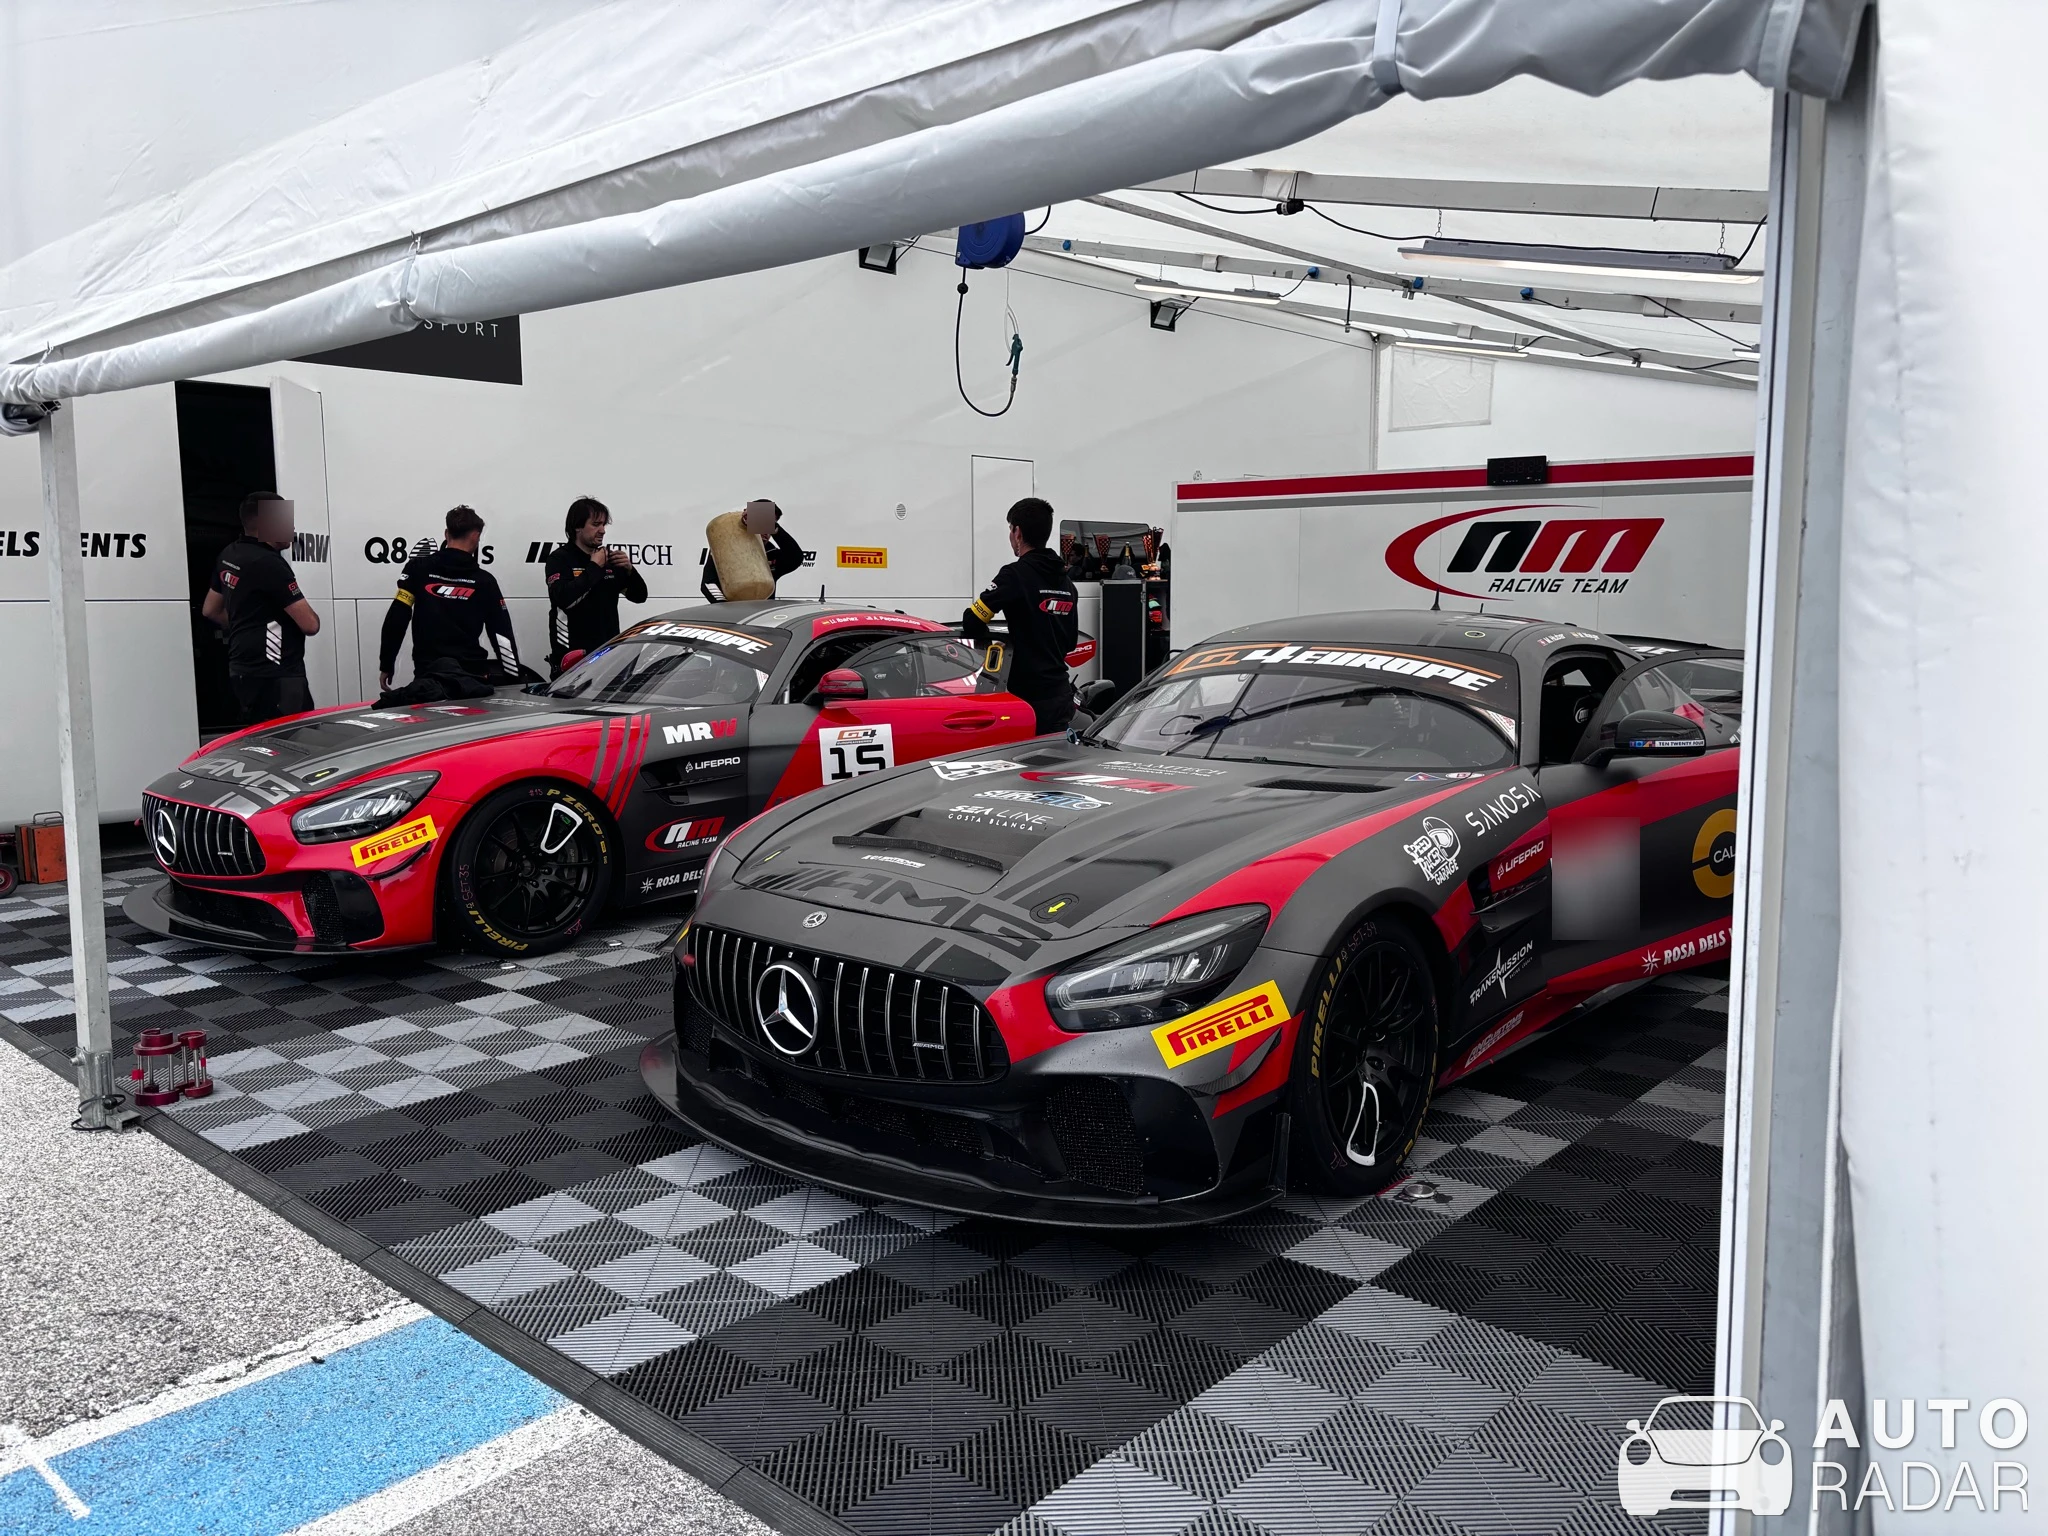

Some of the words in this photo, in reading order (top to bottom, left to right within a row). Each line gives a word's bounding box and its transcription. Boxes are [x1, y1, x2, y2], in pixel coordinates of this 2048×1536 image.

[80, 532, 147, 558] ENTS
[292, 532, 329, 562] MRW
[364, 536, 407, 564] Q8
[841, 550, 883, 565] PIRELLI
[1488, 578, 1565, 593] RACING
[1571, 578, 1629, 594] TEAM
[662, 718, 738, 745] MRW
[694, 756, 741, 770] LIFEPRO
[829, 743, 886, 780] 15
[197, 758, 301, 805] AMG
[562, 794, 604, 836] ZERO
[948, 813, 981, 823] COSTA
[989, 818, 1033, 832] BLANCA
[949, 805, 994, 815] SEA
[996, 809, 1055, 825] LINE
[359, 823, 429, 860] PIRELLI
[677, 838, 700, 849] RACING
[701, 836, 718, 845] TEAM
[1505, 840, 1544, 873] LIFEPRO
[656, 875, 681, 888] ROSA
[682, 868, 704, 883] DELS
[1434, 858, 1459, 886] GARAGE
[468, 910, 529, 951] PIRELLI
[800, 870, 1054, 962] AMG
[1663, 941, 1696, 965] ROSA
[1699, 932, 1727, 954] DELS
[1166, 994, 1275, 1057] PIRELLI
[1310, 956, 1342, 1079] PIRELLI
